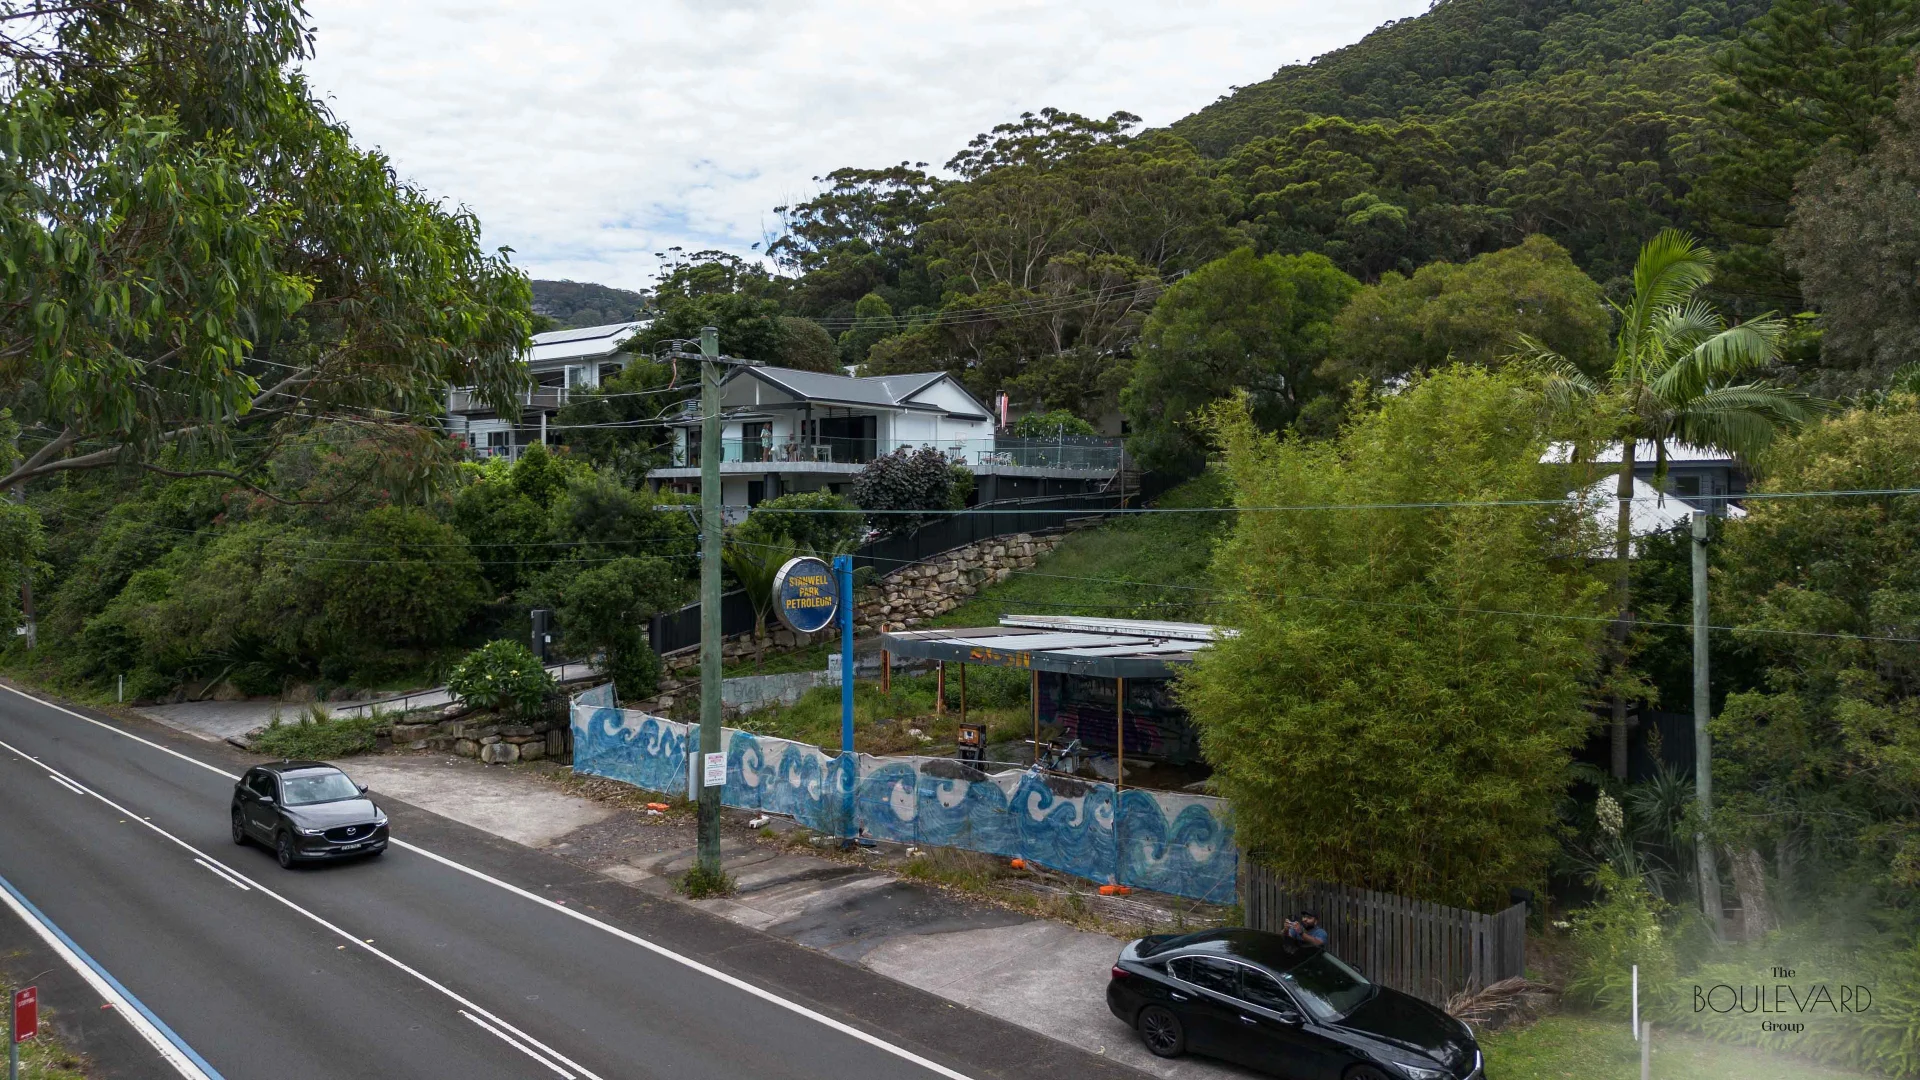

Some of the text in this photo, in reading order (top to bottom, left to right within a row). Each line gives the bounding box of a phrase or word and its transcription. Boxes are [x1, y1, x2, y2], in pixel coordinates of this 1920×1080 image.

[789, 575, 828, 586] STANWELL
[799, 587, 819, 597] PARK
[786, 597, 832, 609] PETROLEUM
